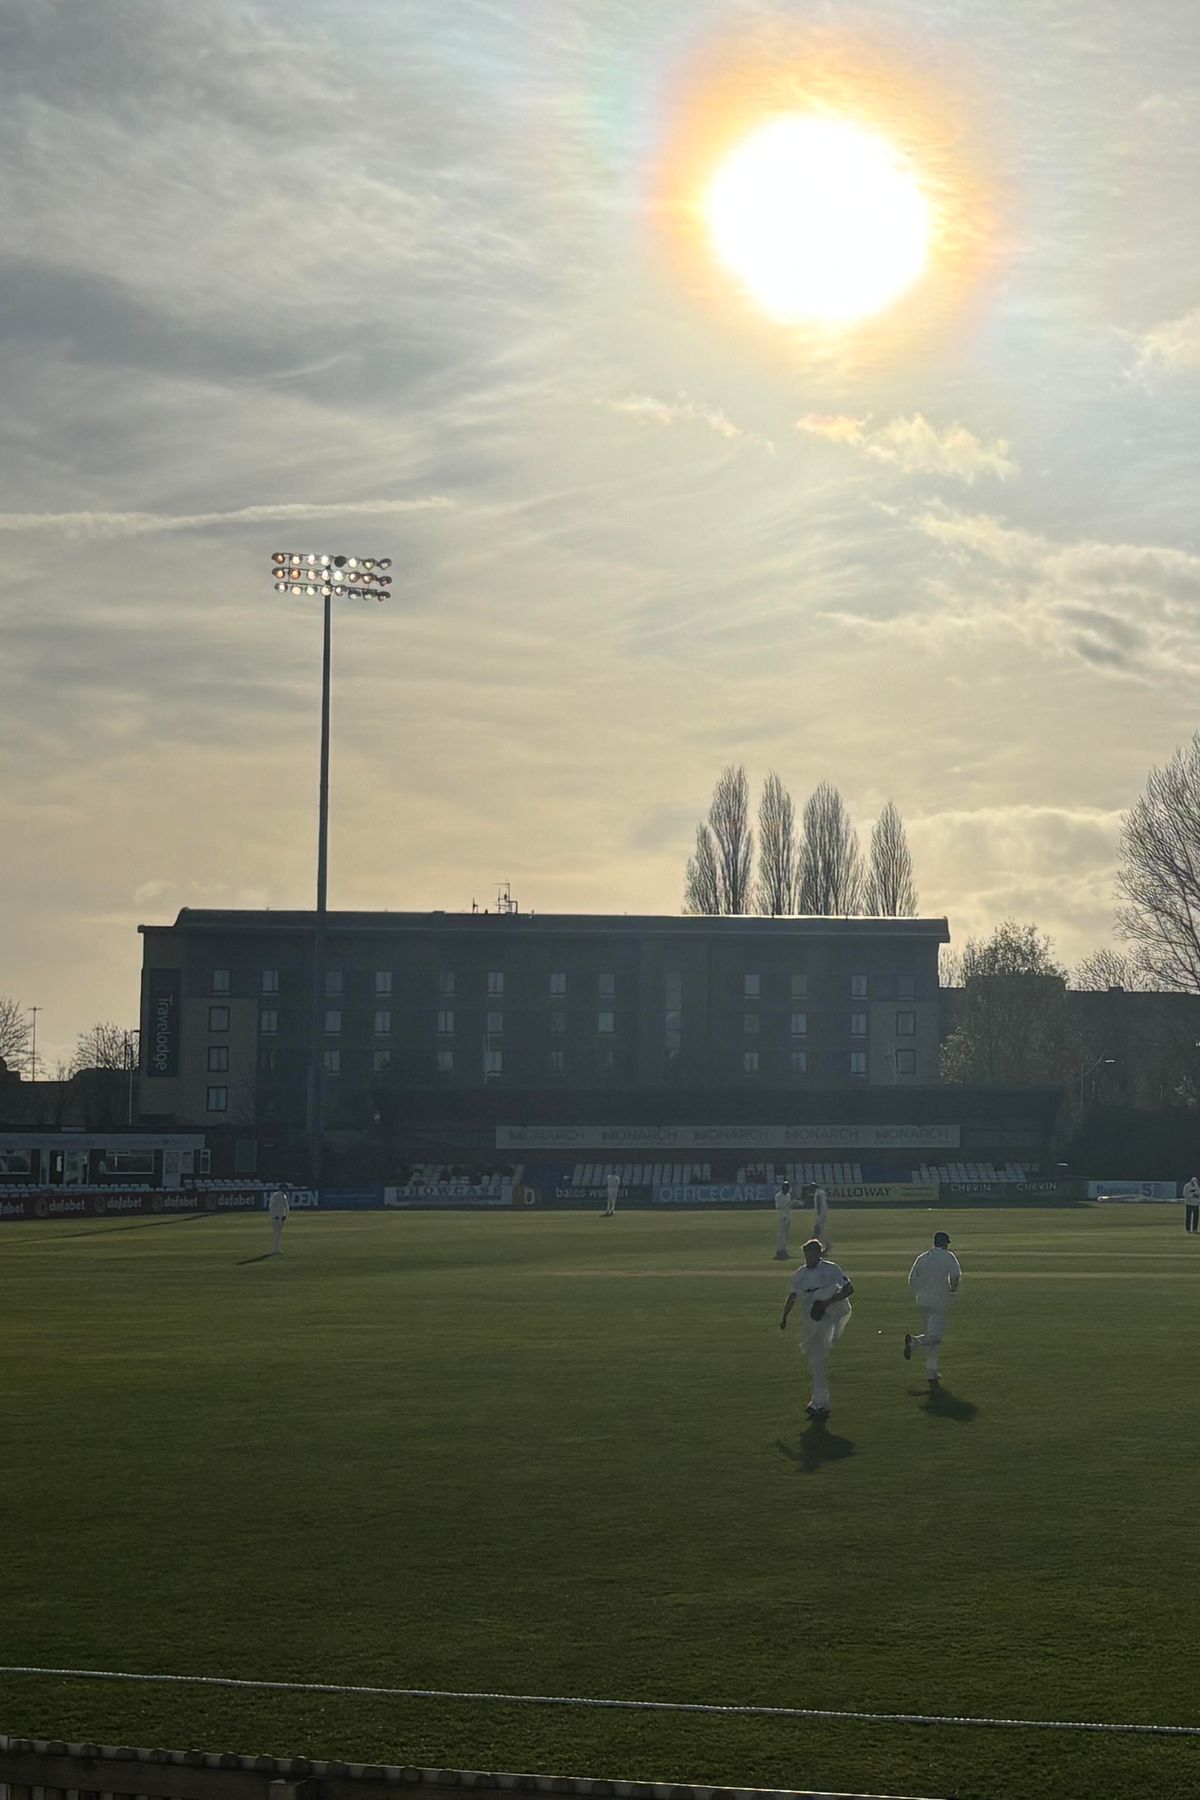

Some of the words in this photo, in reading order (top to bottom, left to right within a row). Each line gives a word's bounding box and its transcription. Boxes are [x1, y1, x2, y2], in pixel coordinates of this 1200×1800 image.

[153, 995, 173, 1071] Travelodge
[509, 1129, 585, 1141] MONARCH
[602, 1129, 678, 1141] MONARCH
[694, 1128, 770, 1140] MONARCH
[785, 1128, 859, 1140] MONARCH
[876, 1128, 950, 1139] MONARCH
[556, 1186, 586, 1198] bates
[951, 1184, 992, 1192] CHEVIN
[1016, 1182, 1057, 1191] CHEVIN
[660, 1185, 767, 1201] OFFICECARE
[49, 1199, 85, 1213] dafabet
[107, 1196, 143, 1210] dafabet
[164, 1195, 199, 1209] dafabet
[218, 1194, 256, 1207] dafabet
